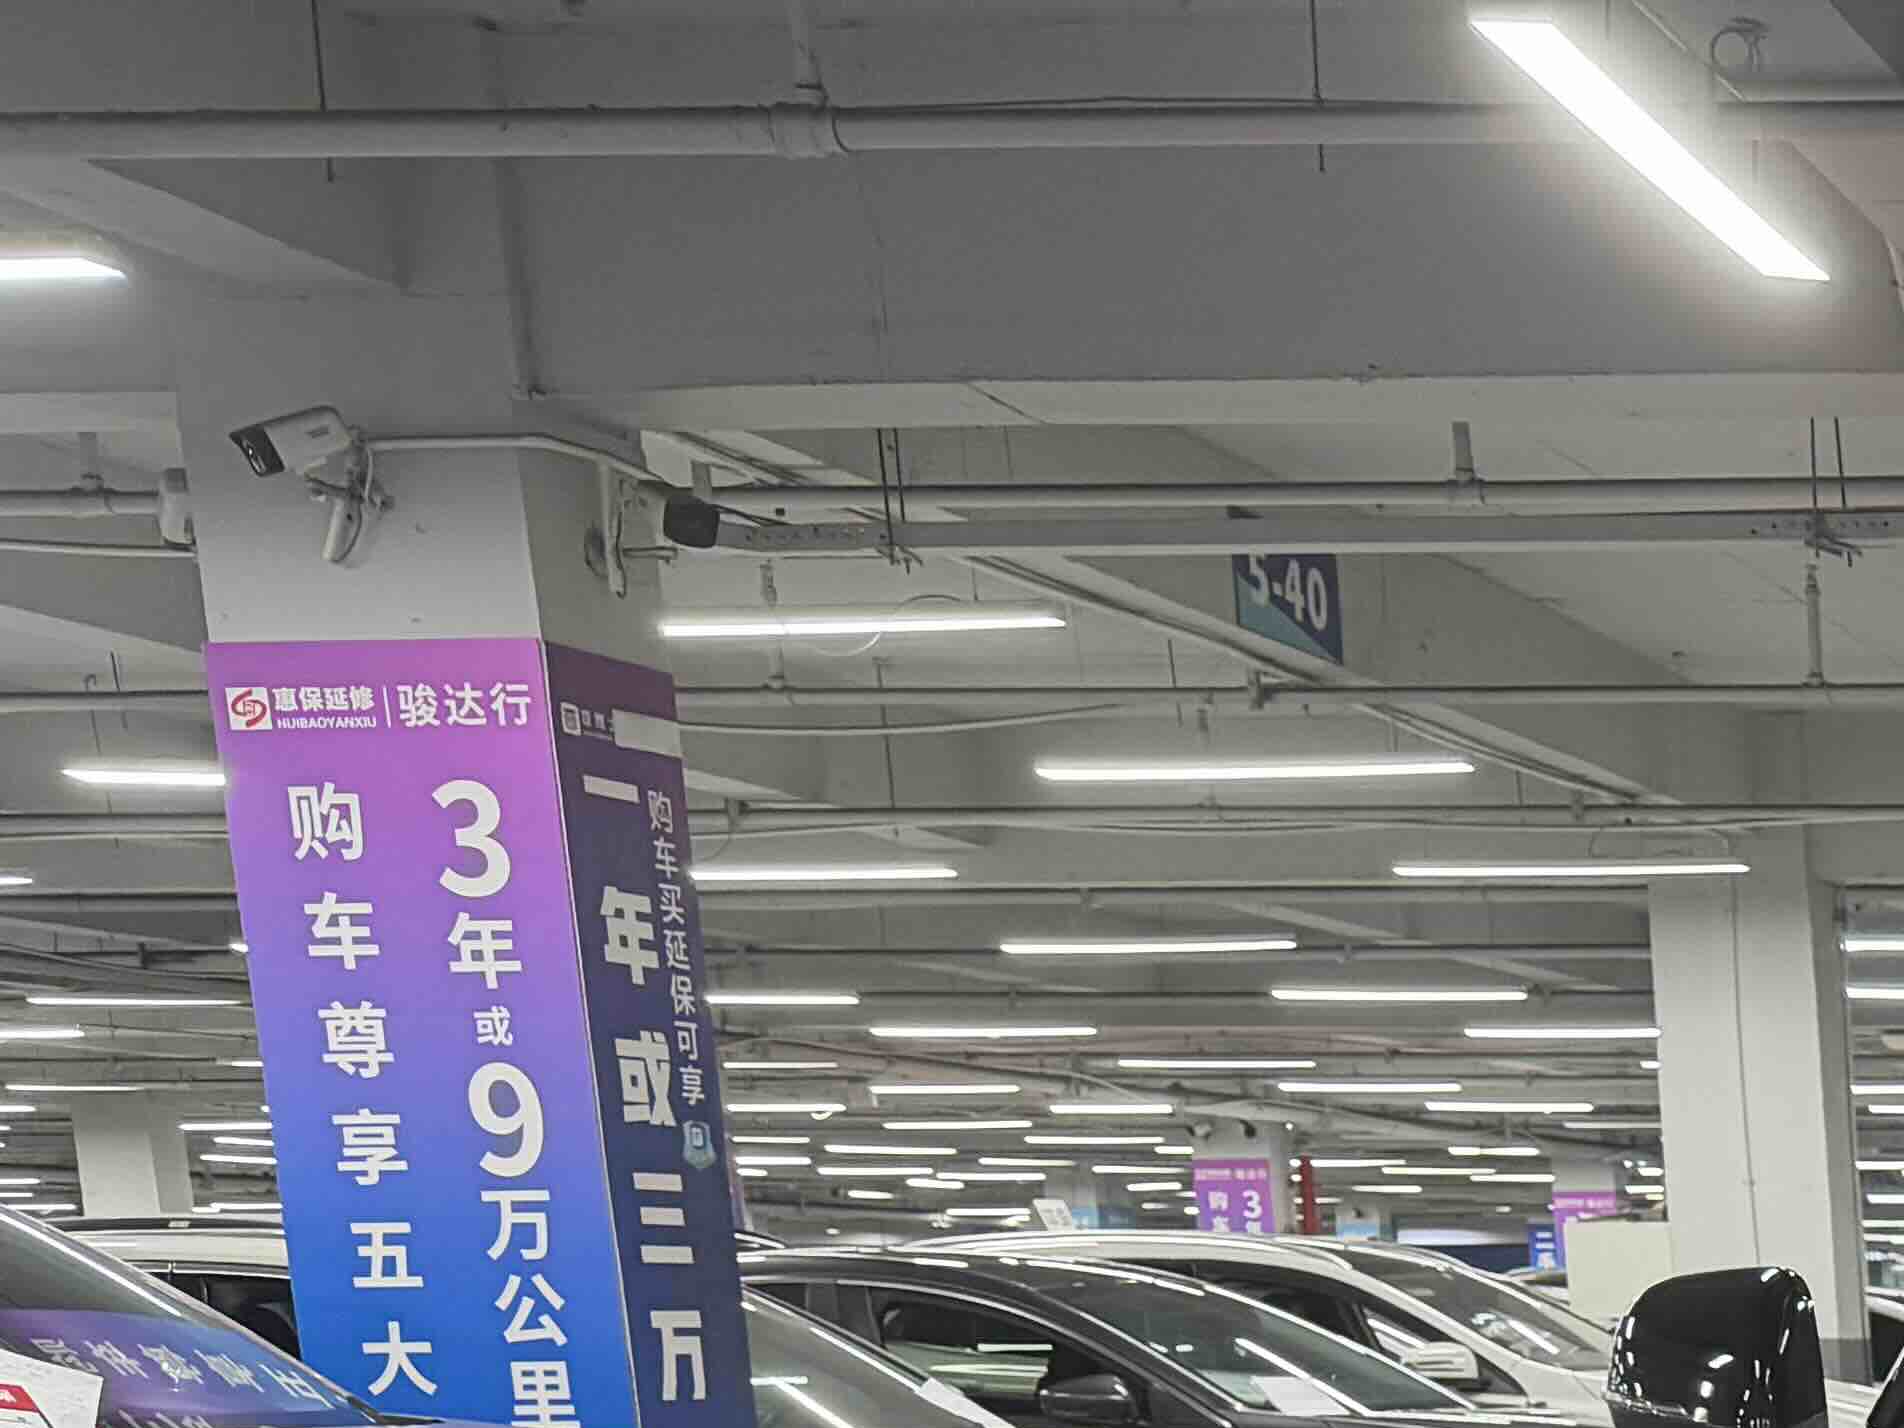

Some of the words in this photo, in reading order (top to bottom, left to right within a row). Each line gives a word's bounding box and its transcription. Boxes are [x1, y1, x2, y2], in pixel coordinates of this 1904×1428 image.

[1247, 550, 1328, 630] 5-40
[272, 685, 375, 712] 惠保延修
[396, 681, 532, 728] 骏达行
[276, 715, 377, 730] HUIBAOYANXIU
[287, 781, 438, 1397] 购车尊享五大
